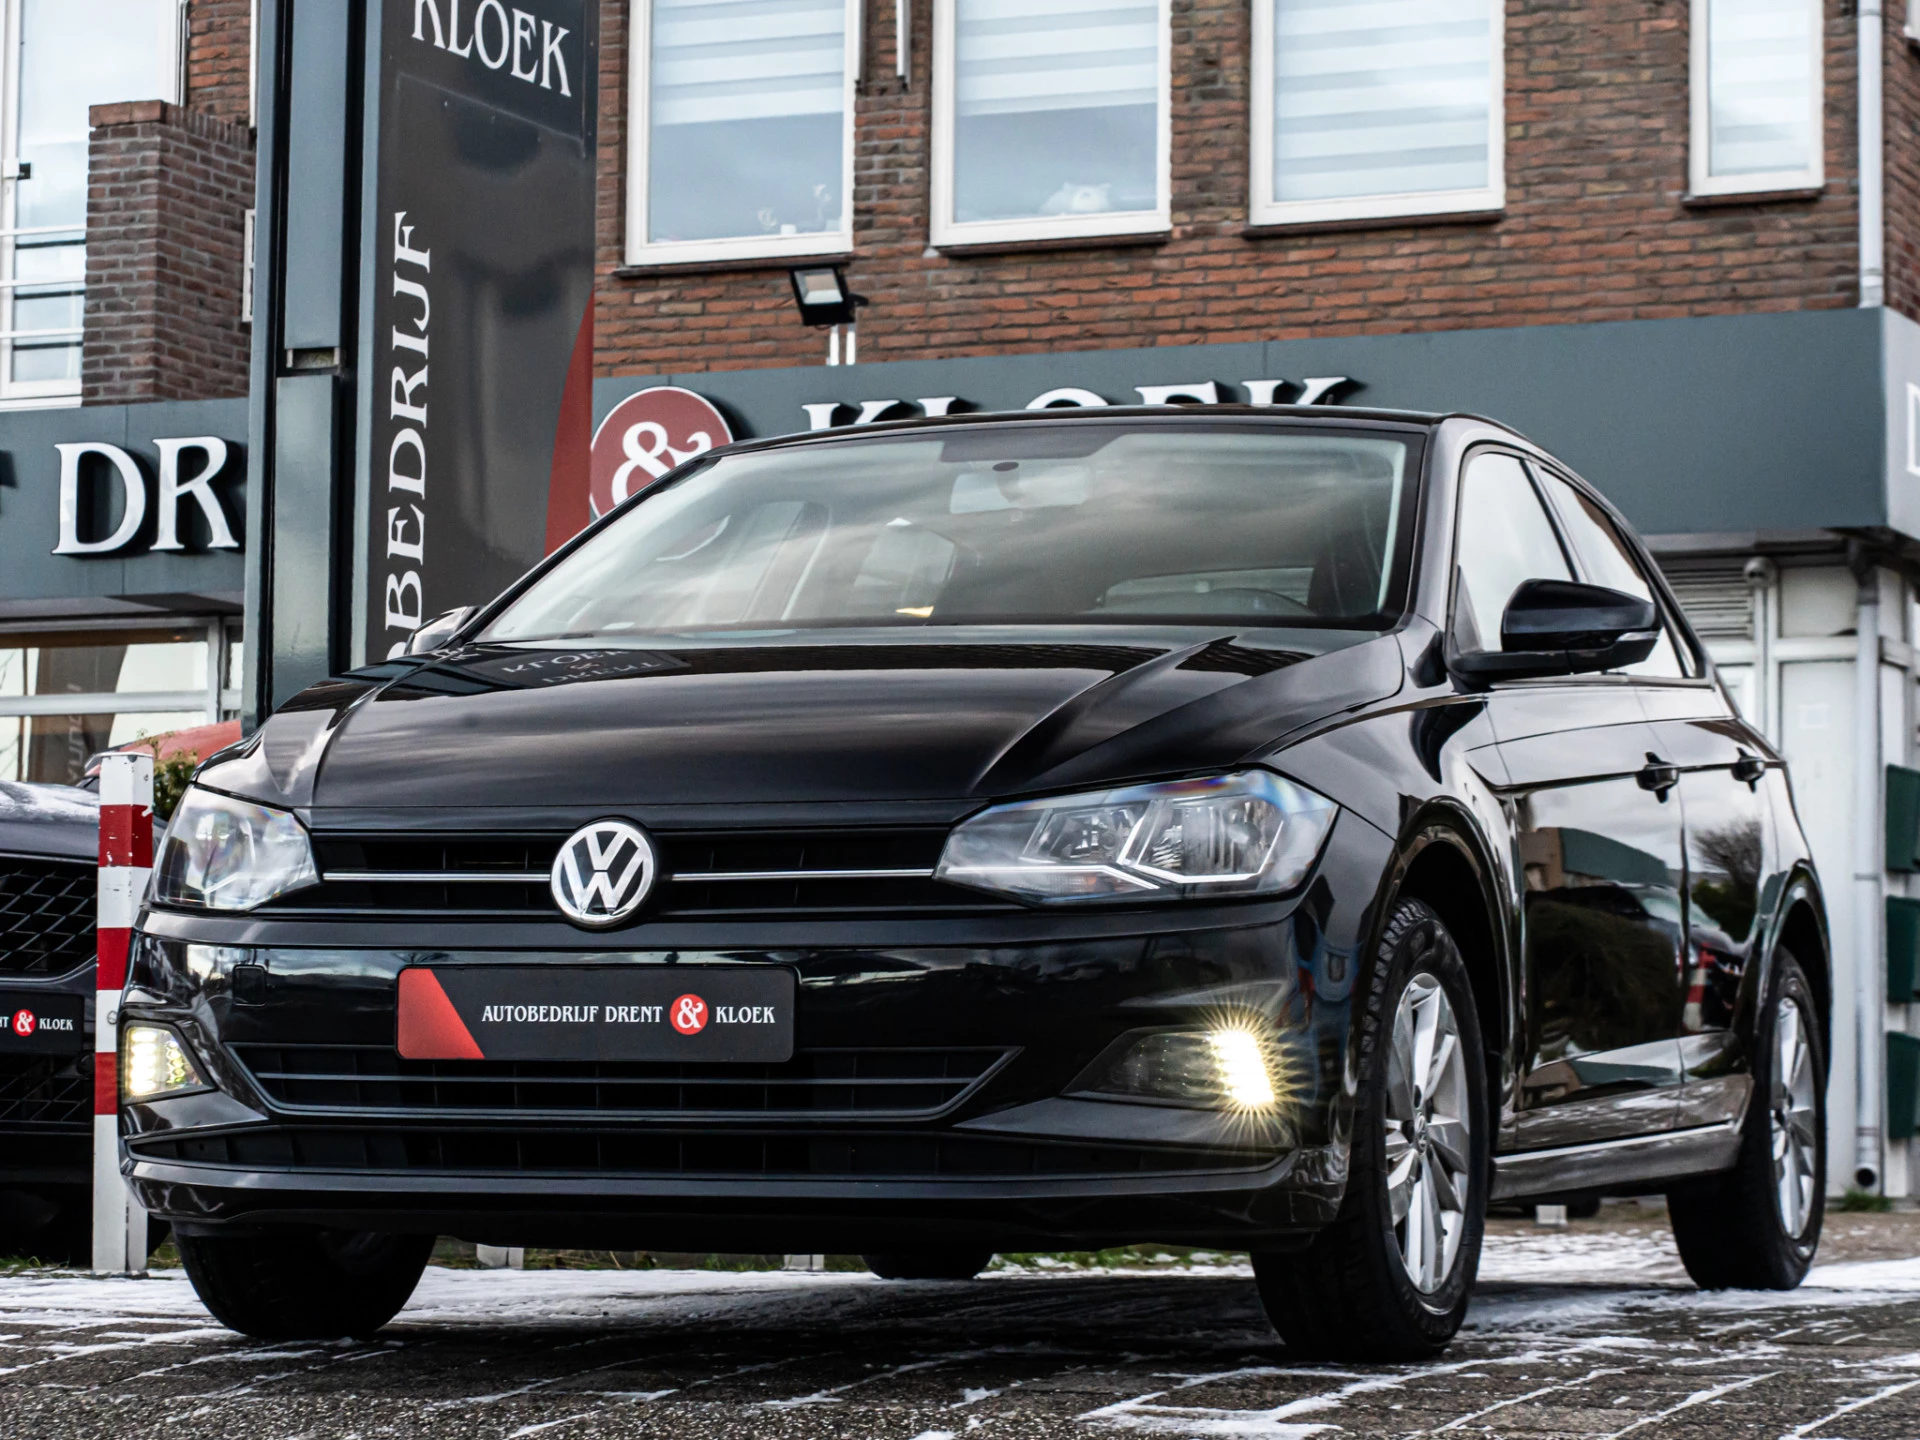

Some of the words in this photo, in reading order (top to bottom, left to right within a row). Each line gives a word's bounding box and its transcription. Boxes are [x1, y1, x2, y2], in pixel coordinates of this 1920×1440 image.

[384, 211, 431, 660] BEDRIJF
[16, 1011, 33, 1033] &
[39, 1018, 74, 1031] KLOEK
[481, 1004, 600, 1023] AUTOBEDRIJF
[604, 1004, 663, 1023] DRENT
[676, 997, 704, 1029] &
[715, 1005, 776, 1024] KLOEK
